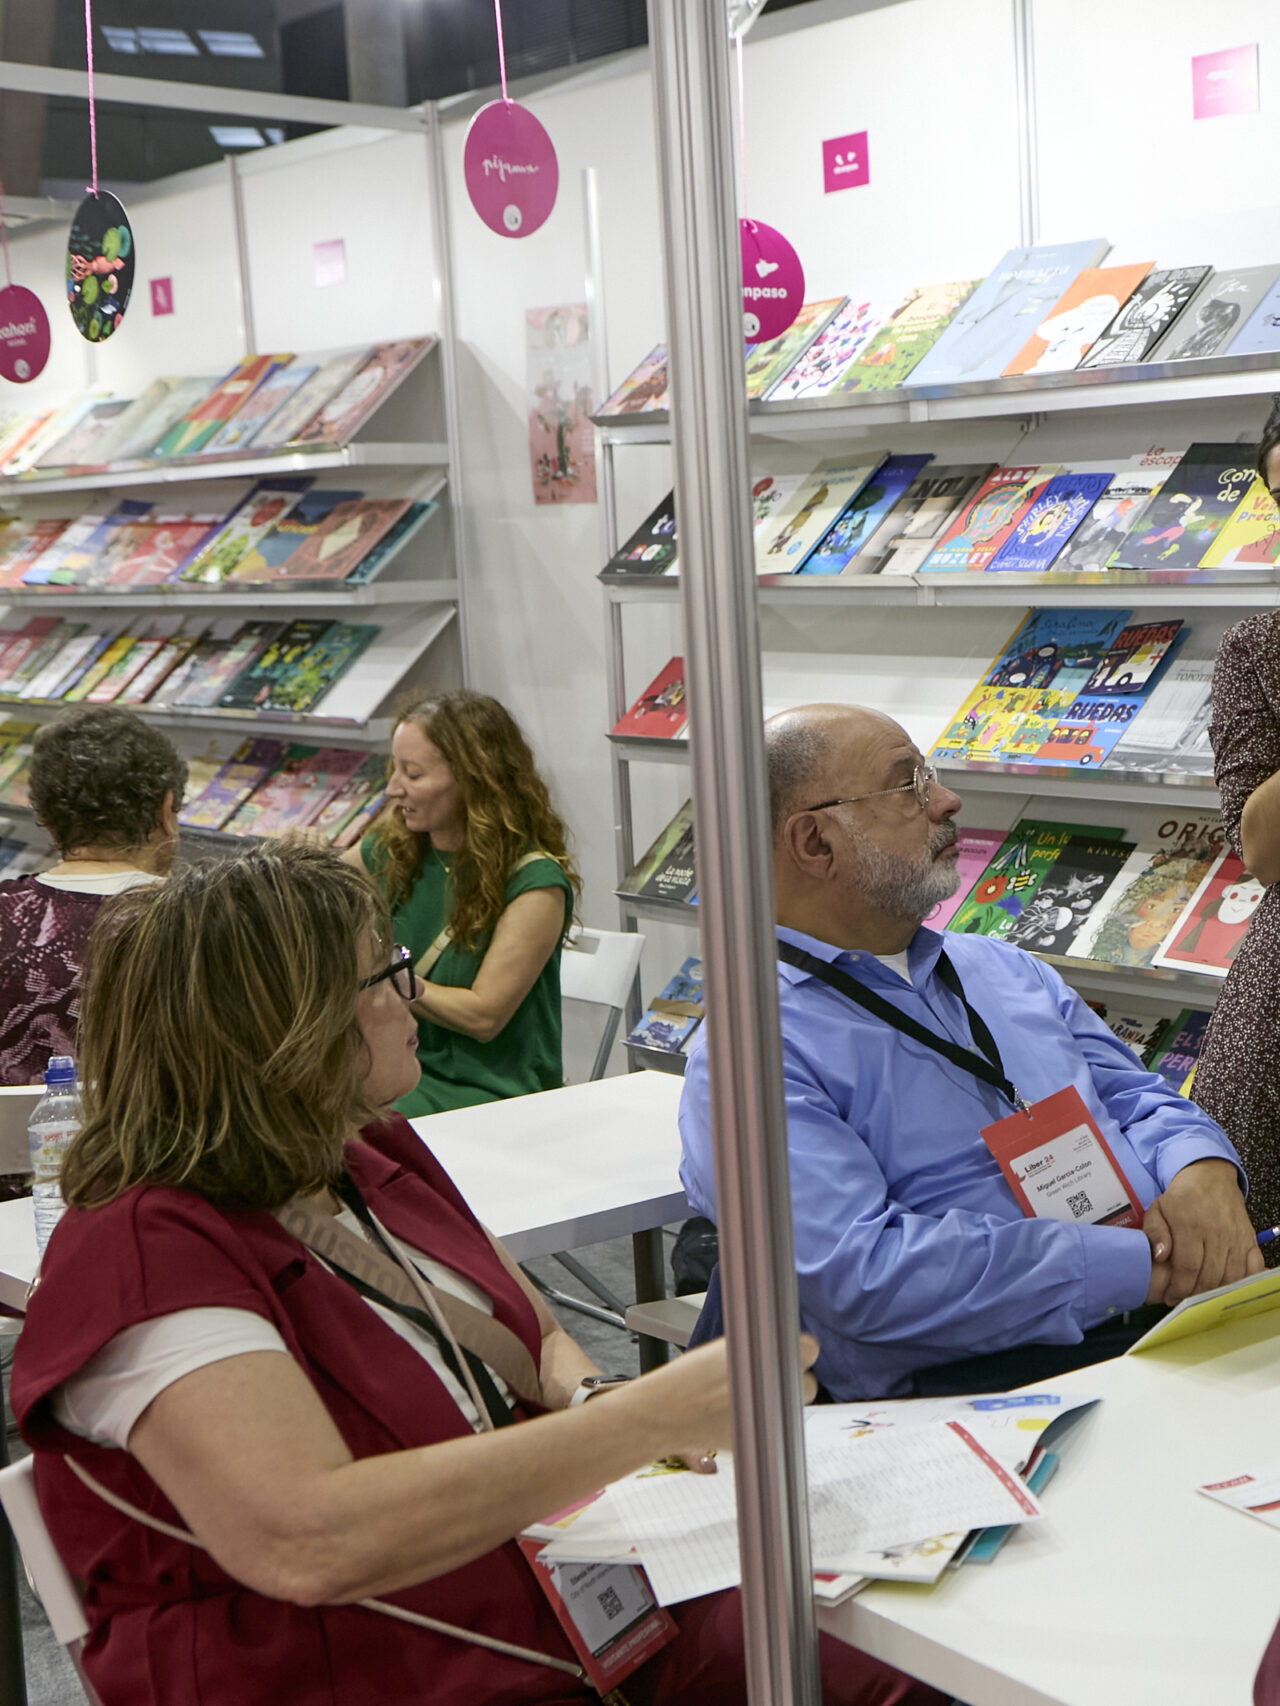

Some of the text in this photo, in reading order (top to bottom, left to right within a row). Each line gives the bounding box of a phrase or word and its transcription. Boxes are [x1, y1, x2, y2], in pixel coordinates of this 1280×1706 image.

[1139, 454, 1184, 468] escap
[991, 470, 1036, 482] ALDO
[1217, 468, 1259, 484] Con
[1216, 483, 1241, 502] de
[1016, 491, 1063, 536] SHIRLEY
[1235, 511, 1280, 523] pregu
[1113, 624, 1179, 650] RUEDAS
[1065, 701, 1138, 723] RUEDAS
[1036, 831, 1071, 846] Un lu
[1157, 820, 1225, 844] ORIG
[1030, 848, 1061, 862] perf
[1024, 1160, 1043, 1173] Liber
[1043, 1154, 1054, 1163] 24
[1036, 1177, 1056, 1192] Miguel
